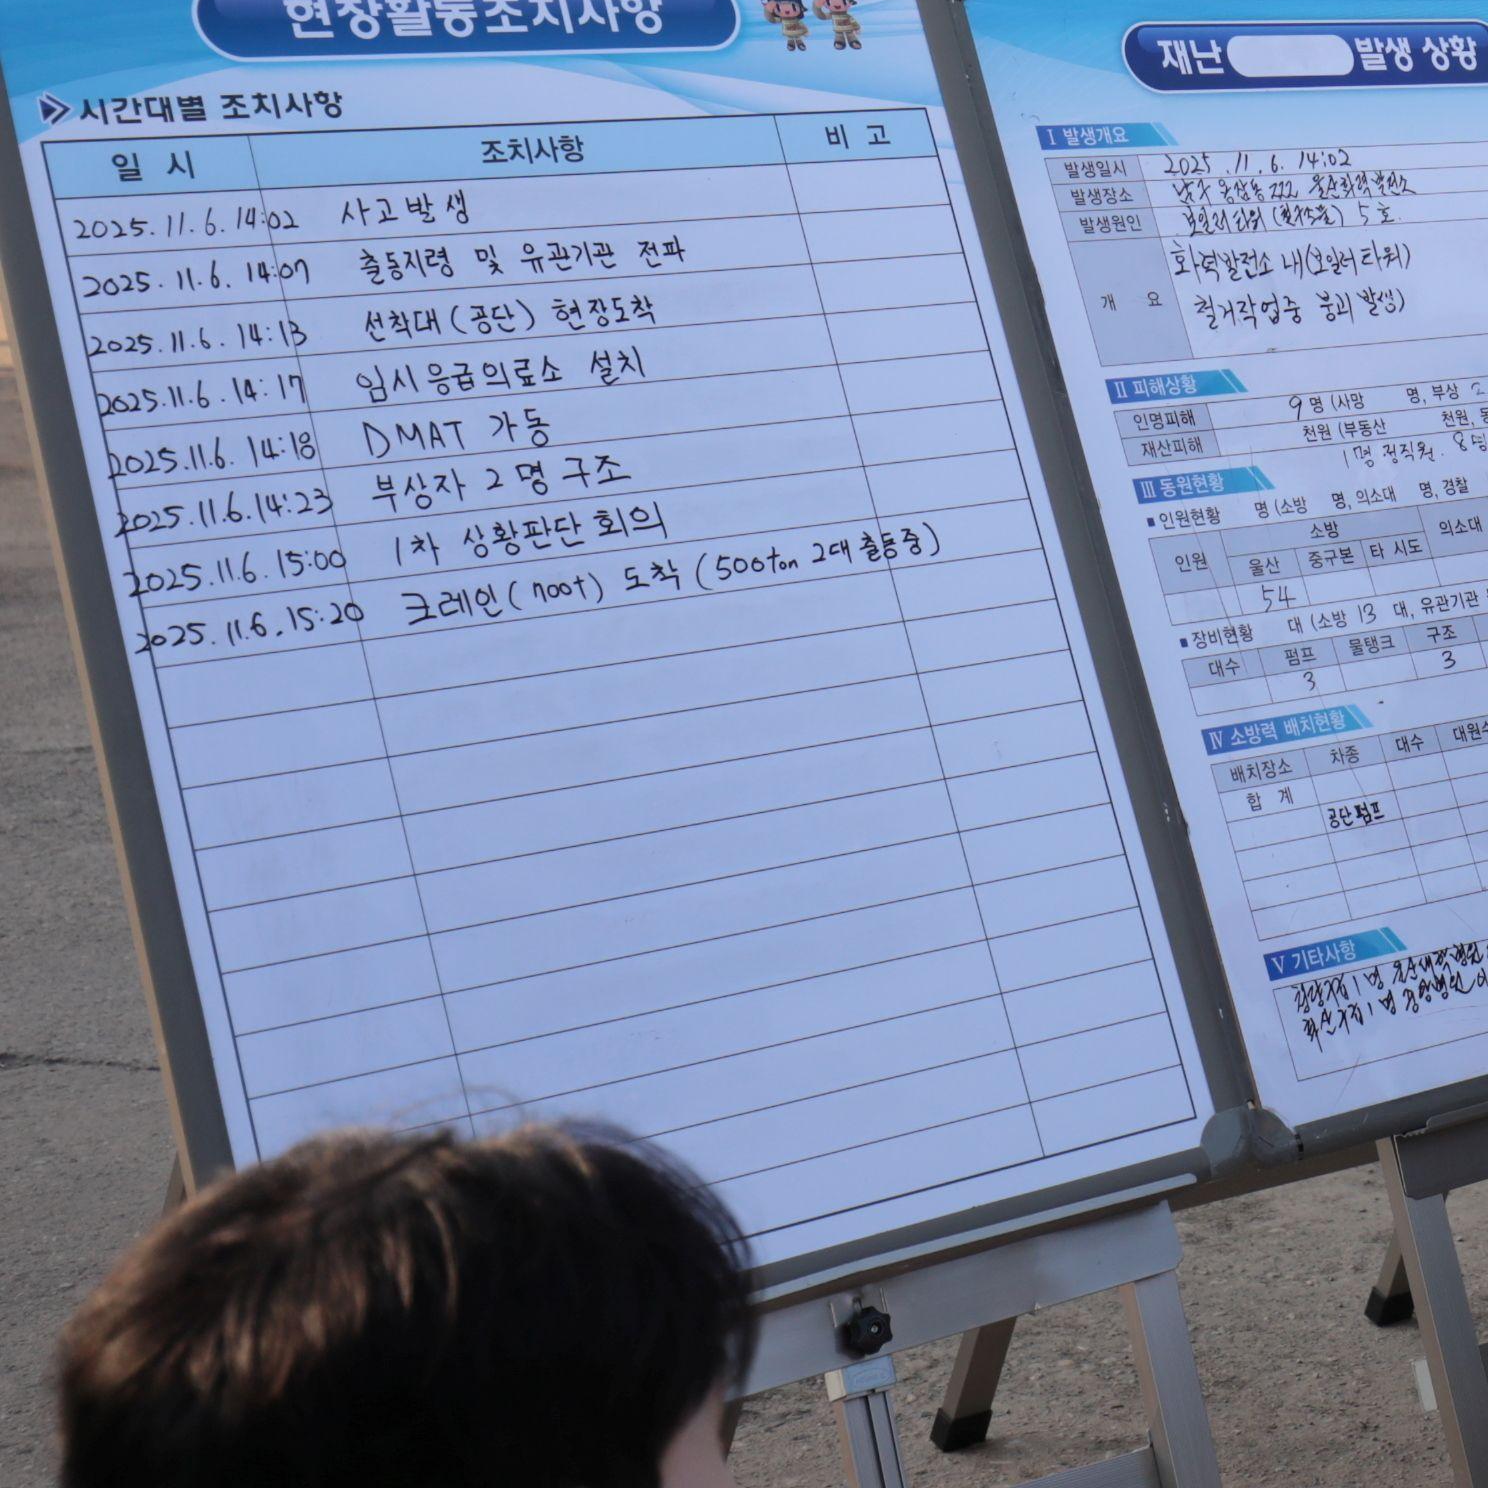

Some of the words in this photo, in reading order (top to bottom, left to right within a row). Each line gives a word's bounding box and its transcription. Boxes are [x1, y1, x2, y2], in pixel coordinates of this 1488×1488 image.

[1157, 39, 1225, 76] 재난
[1354, 37, 1414, 72] 발생
[1422, 36, 1478, 70] 상황
[79, 96, 208, 126] 시간대별
[221, 90, 343, 120] 조치사항
[1063, 127, 1129, 146] 발생개요
[481, 135, 585, 164] 조치사항
[1298, 149, 1351, 170] 14:02
[1064, 161, 1128, 179] 발생일시
[1070, 188, 1134, 205] 발생장소
[1173, 178, 1211, 204] 남구
[237, 206, 299, 231] 14:02
[1079, 214, 1143, 233] 발생원인
[359, 246, 454, 284] 출동지령
[475, 245, 504, 275] 및
[521, 242, 614, 273] 유관기관
[639, 236, 686, 267] 전파
[1170, 240, 1274, 283] 화력발전소
[238, 320, 308, 348] 14:13
[590, 345, 646, 384] 설치
[1134, 374, 1197, 396] 피해상황
[1331, 393, 1364, 412] (사망
[1406, 388, 1426, 405] 명,
[1432, 384, 1459, 399] 부상
[363, 420, 463, 458] DMAT
[490, 407, 551, 448] 가동
[1133, 410, 1197, 431] 인명피해
[1303, 423, 1331, 442] 천원
[1339, 419, 1387, 438] (부동산
[1441, 410, 1475, 427] 천원,
[247, 432, 317, 467] 14:18
[1141, 437, 1203, 458] 재산피해
[373, 468, 466, 512] 부상자
[562, 454, 632, 488] 구조
[1160, 475, 1225, 496] 동원현황
[256, 486, 334, 514] 14:23
[1159, 507, 1220, 530] 인원현황
[1275, 497, 1308, 516] (소방
[1356, 486, 1396, 504] 의소대
[1443, 478, 1469, 496] 경찰
[1310, 520, 1339, 539] 소방
[1439, 517, 1483, 536] 의소대
[624, 560, 680, 593] 도착
[811, 537, 852, 564] 2대
[859, 522, 940, 562] 출동중)
[1308, 547, 1355, 569] 중구본
[1394, 539, 1423, 556] 시도
[278, 549, 347, 578] 15:00
[1175, 552, 1208, 573] 인원
[1249, 557, 1281, 577] 울산
[1261, 585, 1297, 611] 54
[288, 602, 365, 632] 15:20
[1192, 624, 1254, 648] 장비현황
[1311, 611, 1348, 630] (소방
[1358, 603, 1377, 624] 13
[1420, 589, 1479, 616] 유관기관
[1349, 635, 1396, 656] 물탱크
[1427, 624, 1457, 642] 구조
[1208, 656, 1241, 678] 대수
[1284, 646, 1317, 667] 펌프
[1443, 650, 1456, 669] 3
[1304, 671, 1316, 691] 3
[1231, 722, 1279, 744] 소방력
[1283, 705, 1346, 738] 배치현황
[1396, 734, 1425, 753] 대수
[1330, 748, 1361, 765] 차종
[1230, 759, 1293, 784] 배치장소
[1292, 939, 1356, 971] 기타사항
